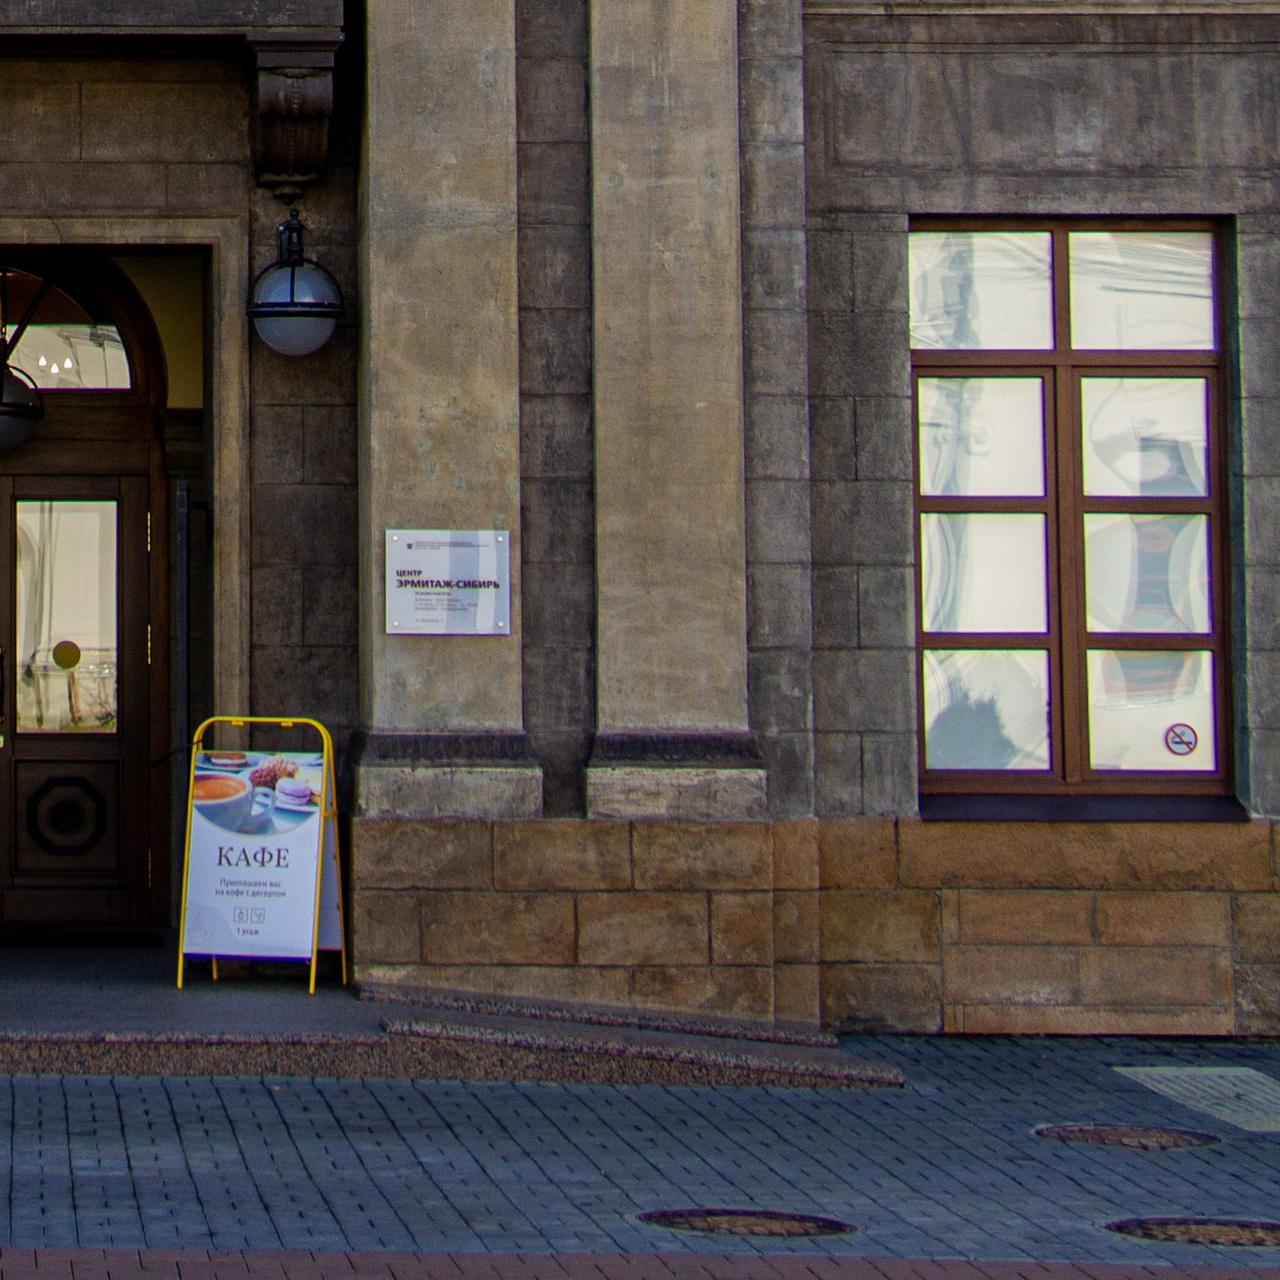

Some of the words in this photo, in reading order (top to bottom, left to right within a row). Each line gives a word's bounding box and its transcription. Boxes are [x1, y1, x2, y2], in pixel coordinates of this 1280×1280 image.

[396, 570, 422, 578] ЦЕНТР
[396, 579, 500, 589] ЭРМИТАЖ-СИБИРЬ
[218, 847, 289, 868] КАФЕ
